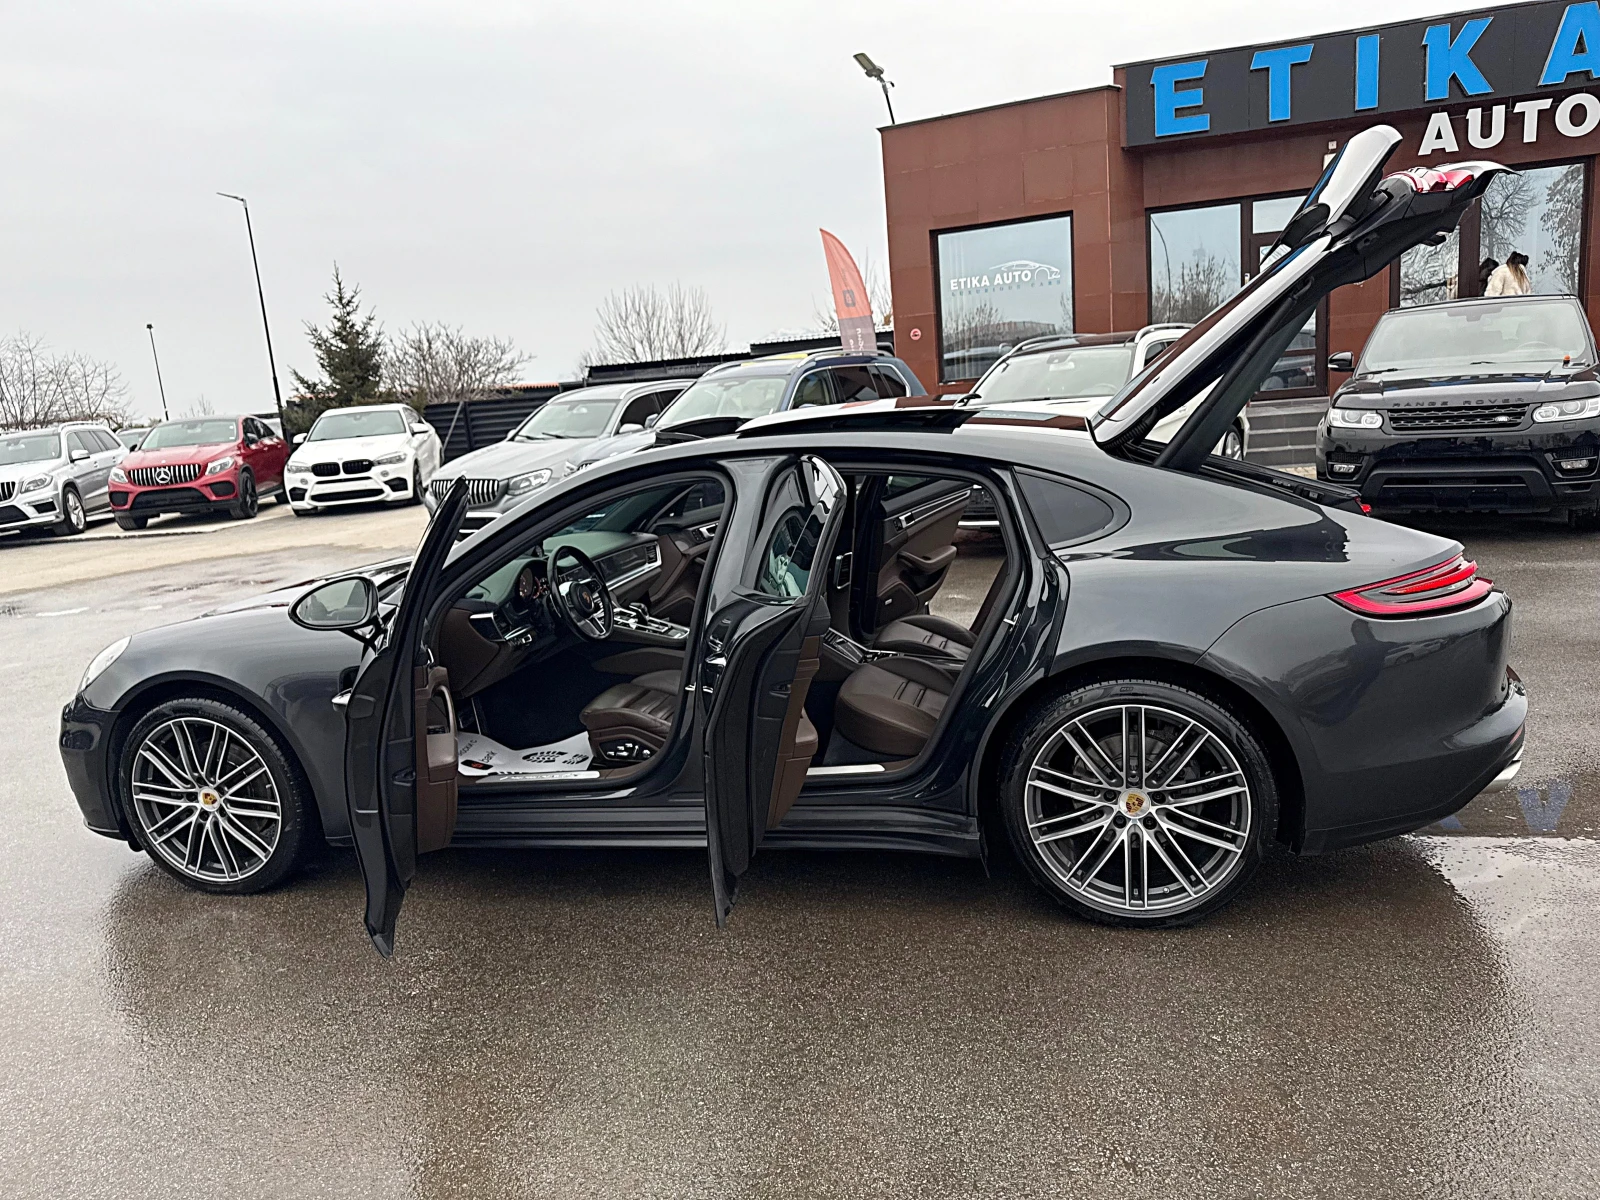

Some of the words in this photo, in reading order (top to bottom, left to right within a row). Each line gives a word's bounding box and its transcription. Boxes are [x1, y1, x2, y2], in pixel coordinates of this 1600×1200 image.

[1150, 1, 1600, 137] ETIKA
[1418, 93, 1600, 156] AUTO
[950, 275, 990, 290] ETIKA
[994, 270, 1032, 286] AUTO
[1463, 397, 1525, 406] ROVER
